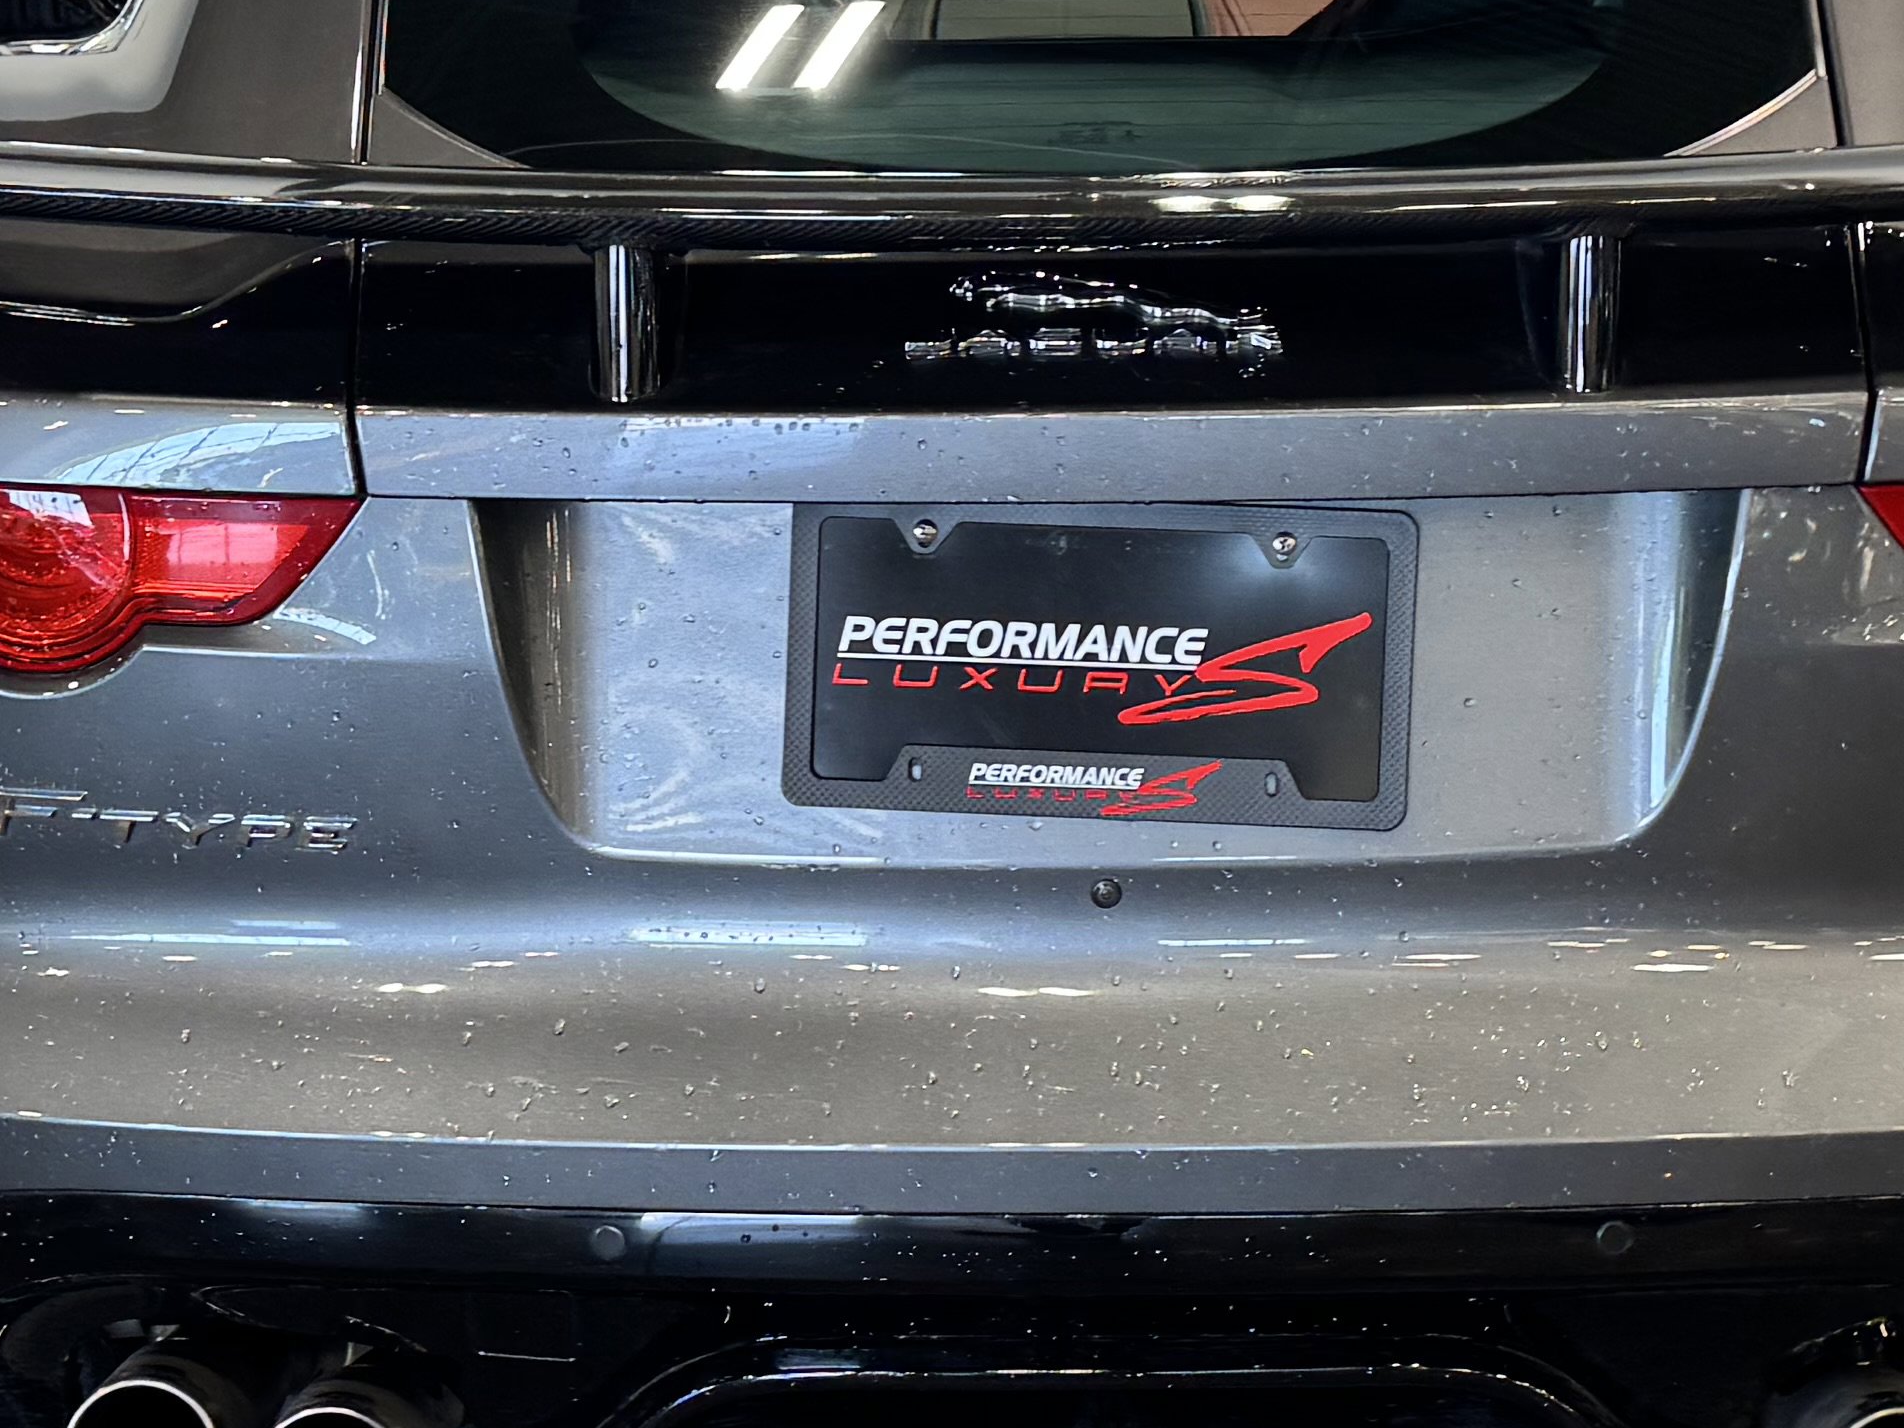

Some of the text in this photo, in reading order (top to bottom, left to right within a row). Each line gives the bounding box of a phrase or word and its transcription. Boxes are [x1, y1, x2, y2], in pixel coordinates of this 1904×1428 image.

[837, 616, 1208, 664] PERFORMANCE
[832, 663, 1192, 697] LUXURY
[969, 763, 1144, 787] PERFORMANCE
[966, 786, 1136, 802] LUXURY
